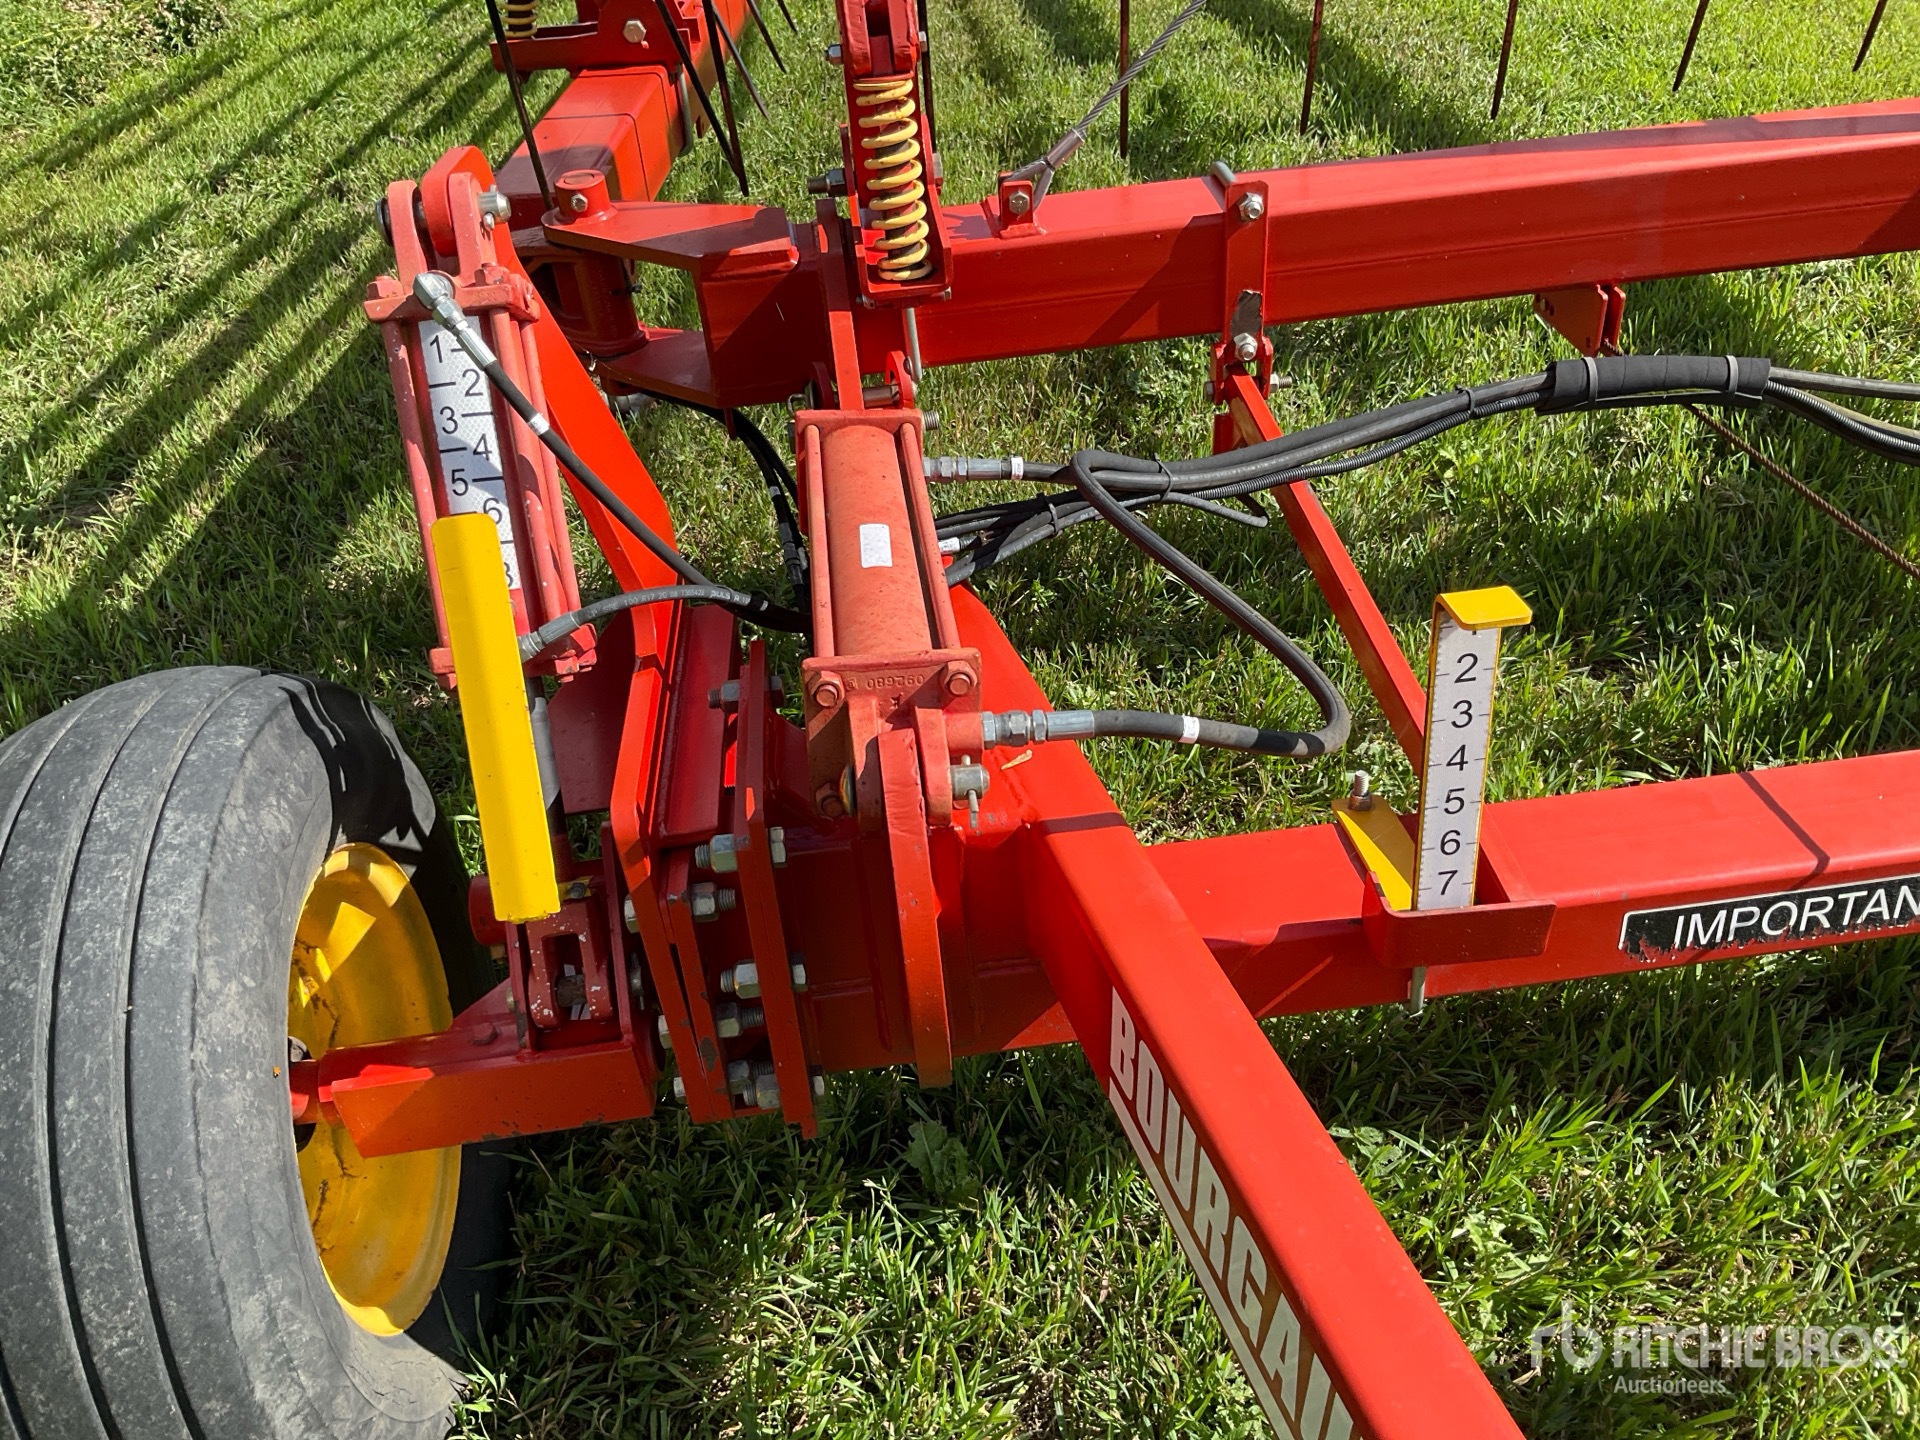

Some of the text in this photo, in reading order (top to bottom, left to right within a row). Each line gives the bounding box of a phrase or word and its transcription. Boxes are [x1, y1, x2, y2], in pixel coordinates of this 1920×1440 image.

[429, 334, 443, 363] 1
[462, 368, 483, 397] 2
[440, 406, 458, 434] 3
[472, 433, 492, 461] 4
[451, 468, 469, 496] 5
[483, 498, 502, 525] 6
[1454, 652, 1478, 684] 2
[1451, 699, 1473, 729] 3
[1446, 744, 1468, 771] 4
[1443, 787, 1465, 815] 5
[1440, 829, 1461, 856] 6
[1438, 869, 1458, 896] 7
